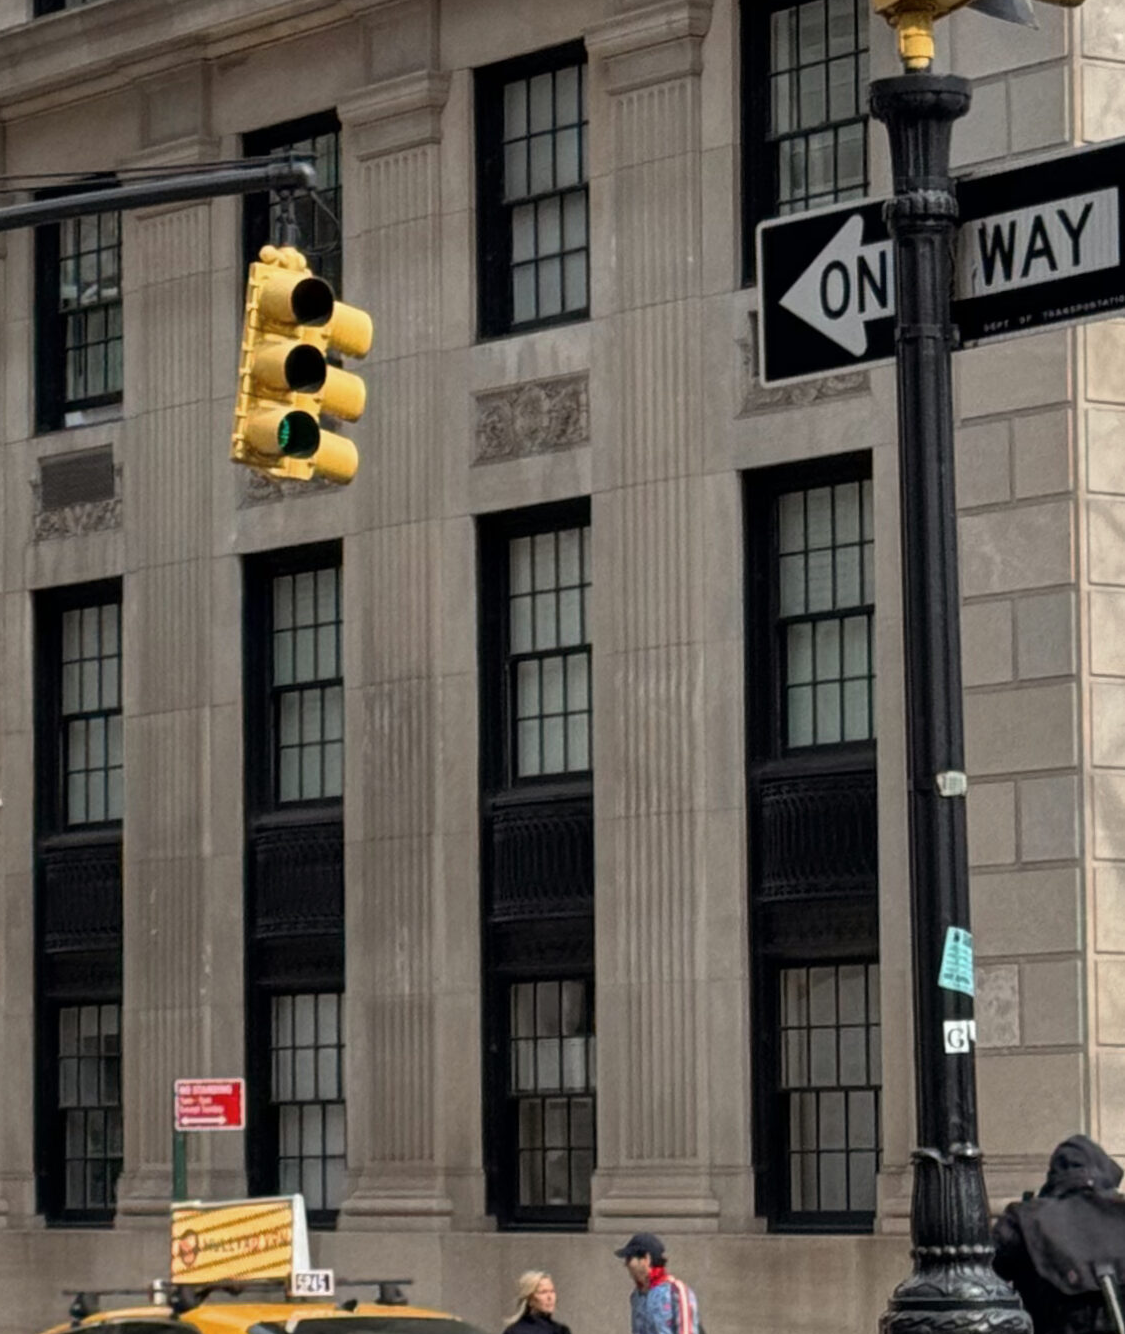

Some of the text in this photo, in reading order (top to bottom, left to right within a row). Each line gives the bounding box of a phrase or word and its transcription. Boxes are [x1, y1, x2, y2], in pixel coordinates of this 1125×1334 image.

[820, 202, 1094, 320] ON WAY
[1042, 293, 1125, 321] TRANSPORTATIO
[946, 1027, 965, 1049] G
